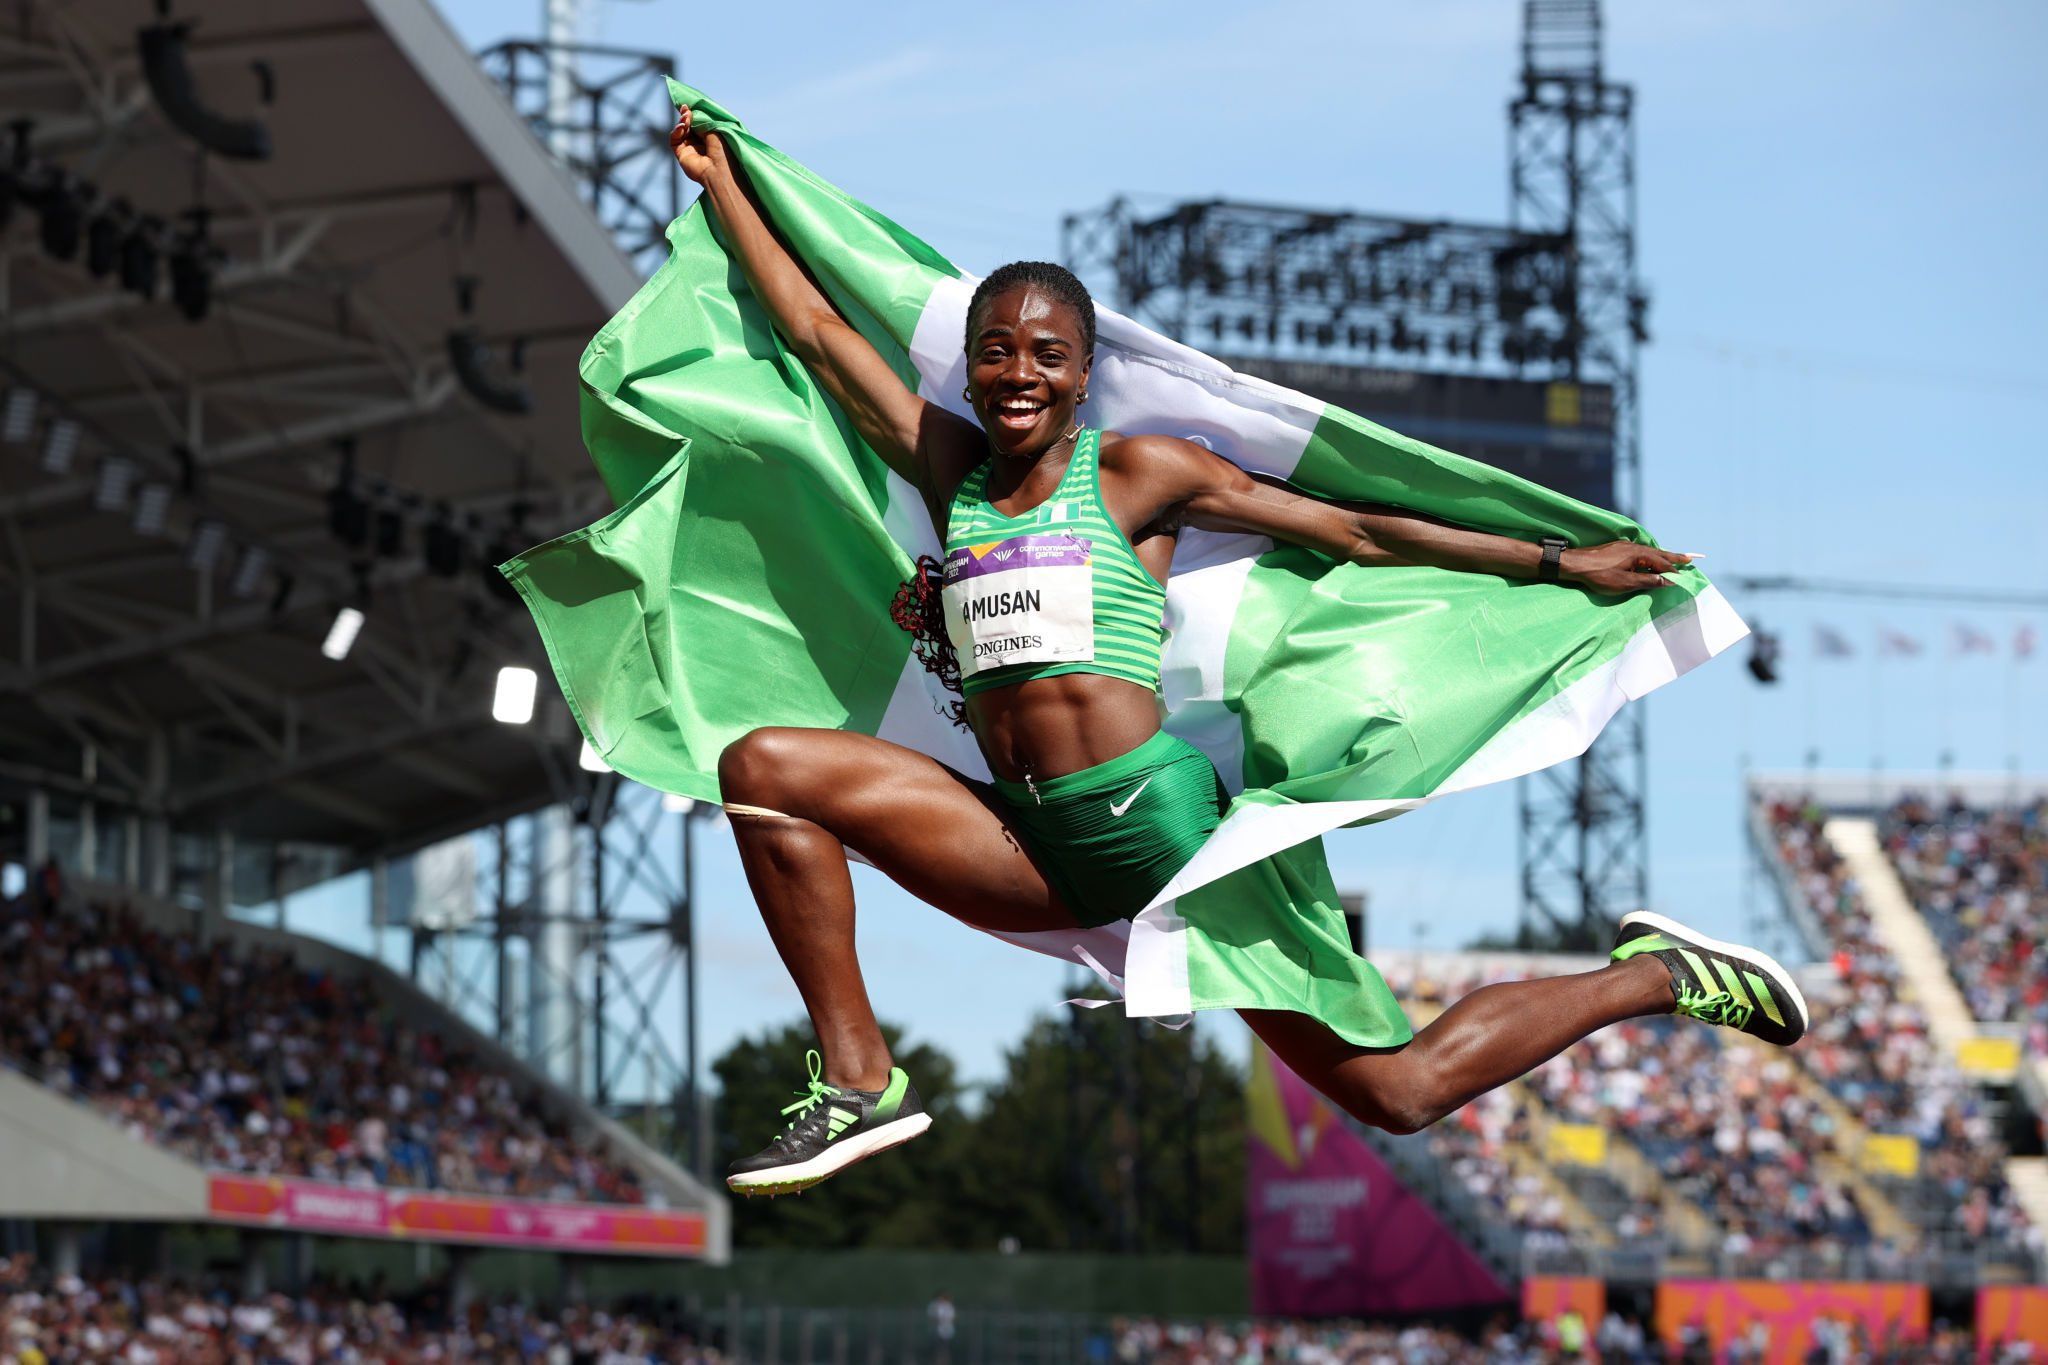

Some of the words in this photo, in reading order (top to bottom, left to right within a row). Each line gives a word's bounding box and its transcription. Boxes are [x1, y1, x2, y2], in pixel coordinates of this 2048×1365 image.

[1035, 551, 1065, 560] games
[943, 556, 969, 574] RMINGHAM
[948, 567, 960, 579] 2022
[963, 589, 1041, 625] AMUSAN
